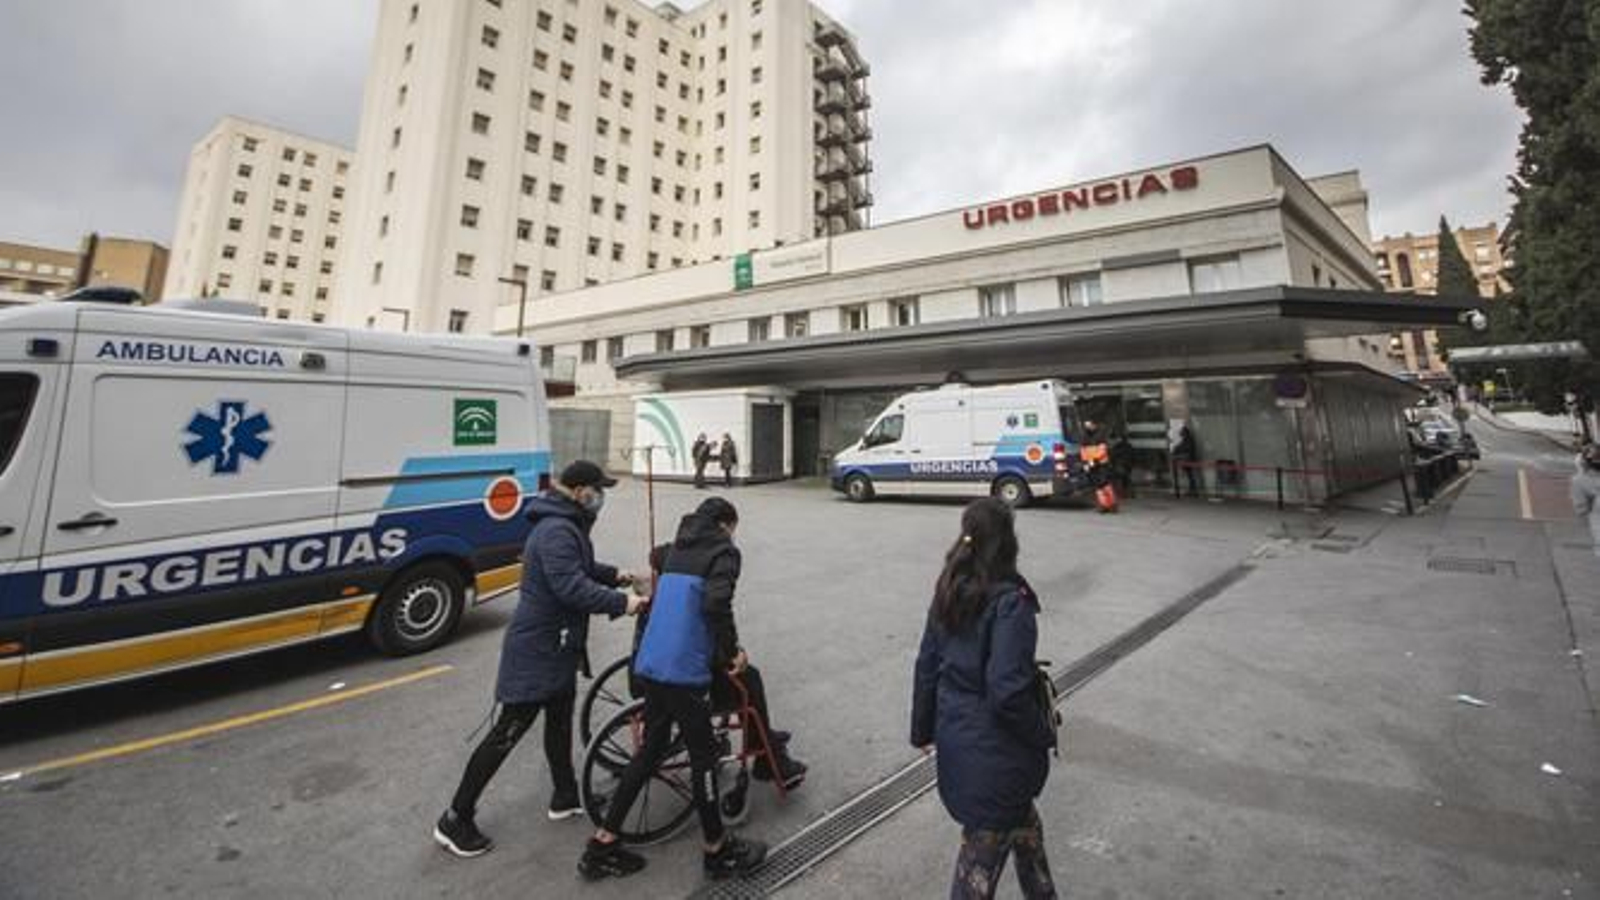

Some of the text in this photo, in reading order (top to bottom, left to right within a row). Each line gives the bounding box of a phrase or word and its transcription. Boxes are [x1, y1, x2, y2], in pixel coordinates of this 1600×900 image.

[963, 166, 1198, 230] URGENCIAS
[96, 340, 284, 367] AMBULANCIA
[910, 459, 998, 474] URGENCIAS
[41, 528, 407, 606] URGENCIAS
